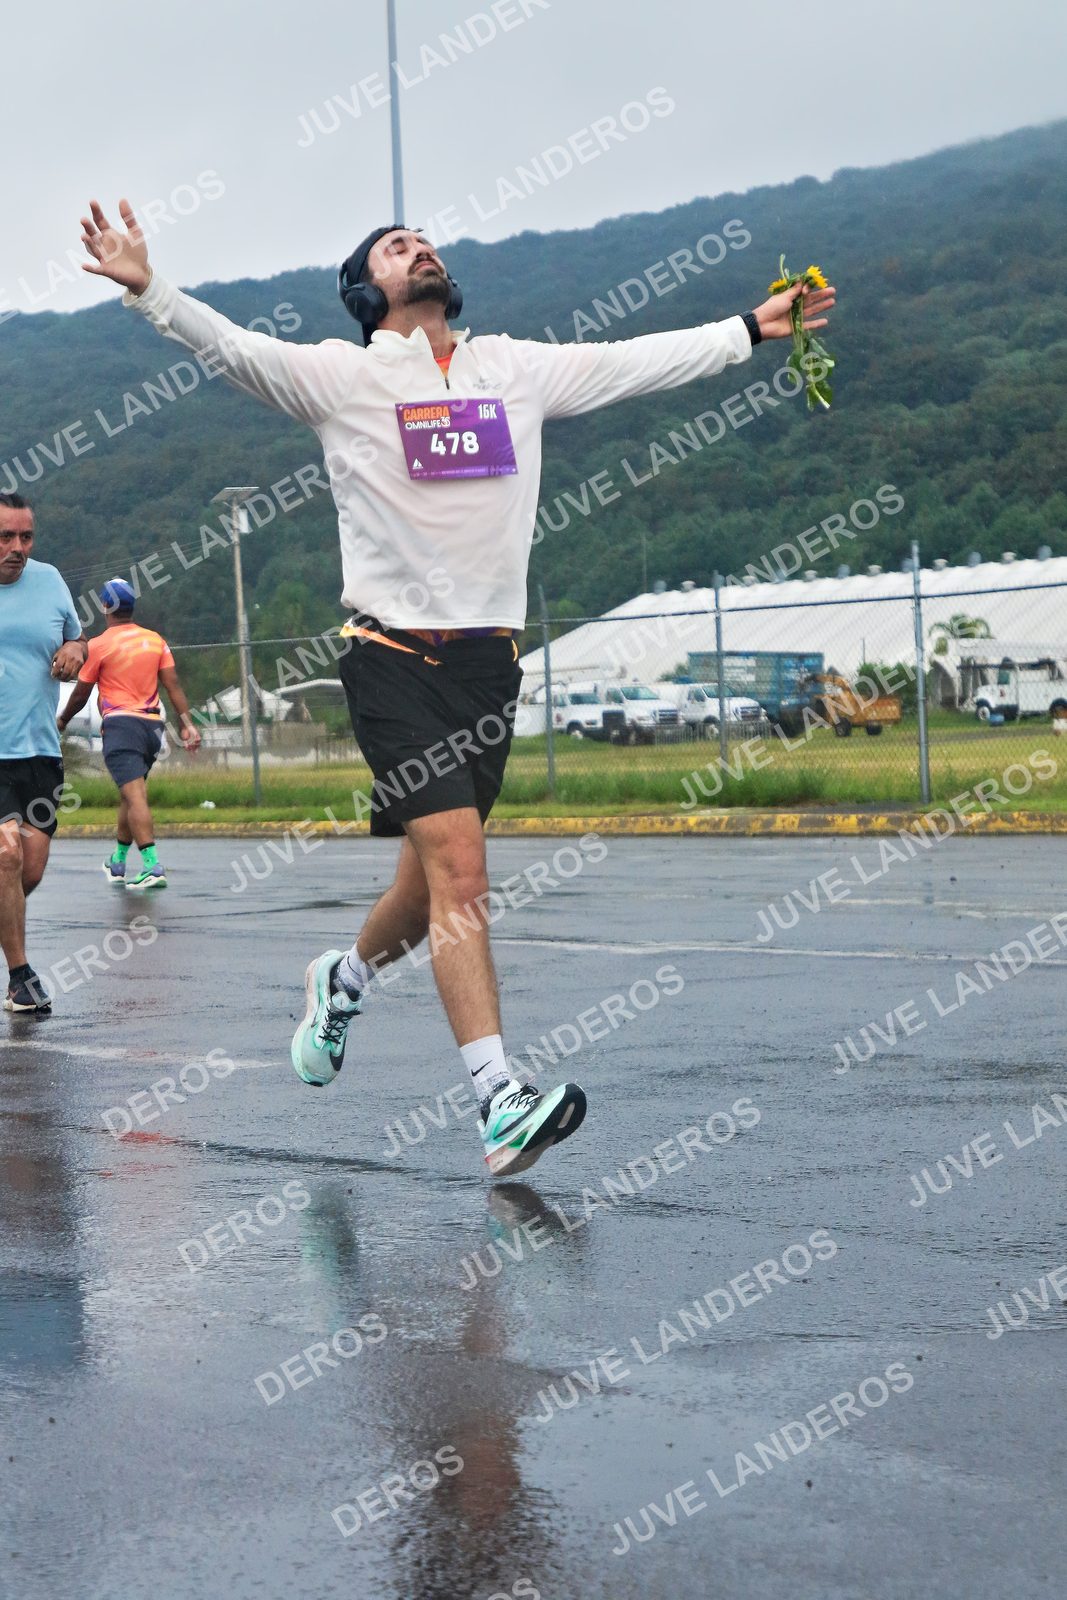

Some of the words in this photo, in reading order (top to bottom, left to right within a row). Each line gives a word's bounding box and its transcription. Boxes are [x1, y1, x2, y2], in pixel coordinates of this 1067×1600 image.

[403, 405, 450, 421] CARRERA
[477, 403, 498, 419] 16K
[405, 419, 441, 430] OMNILIFE
[430, 431, 480, 456] 478
